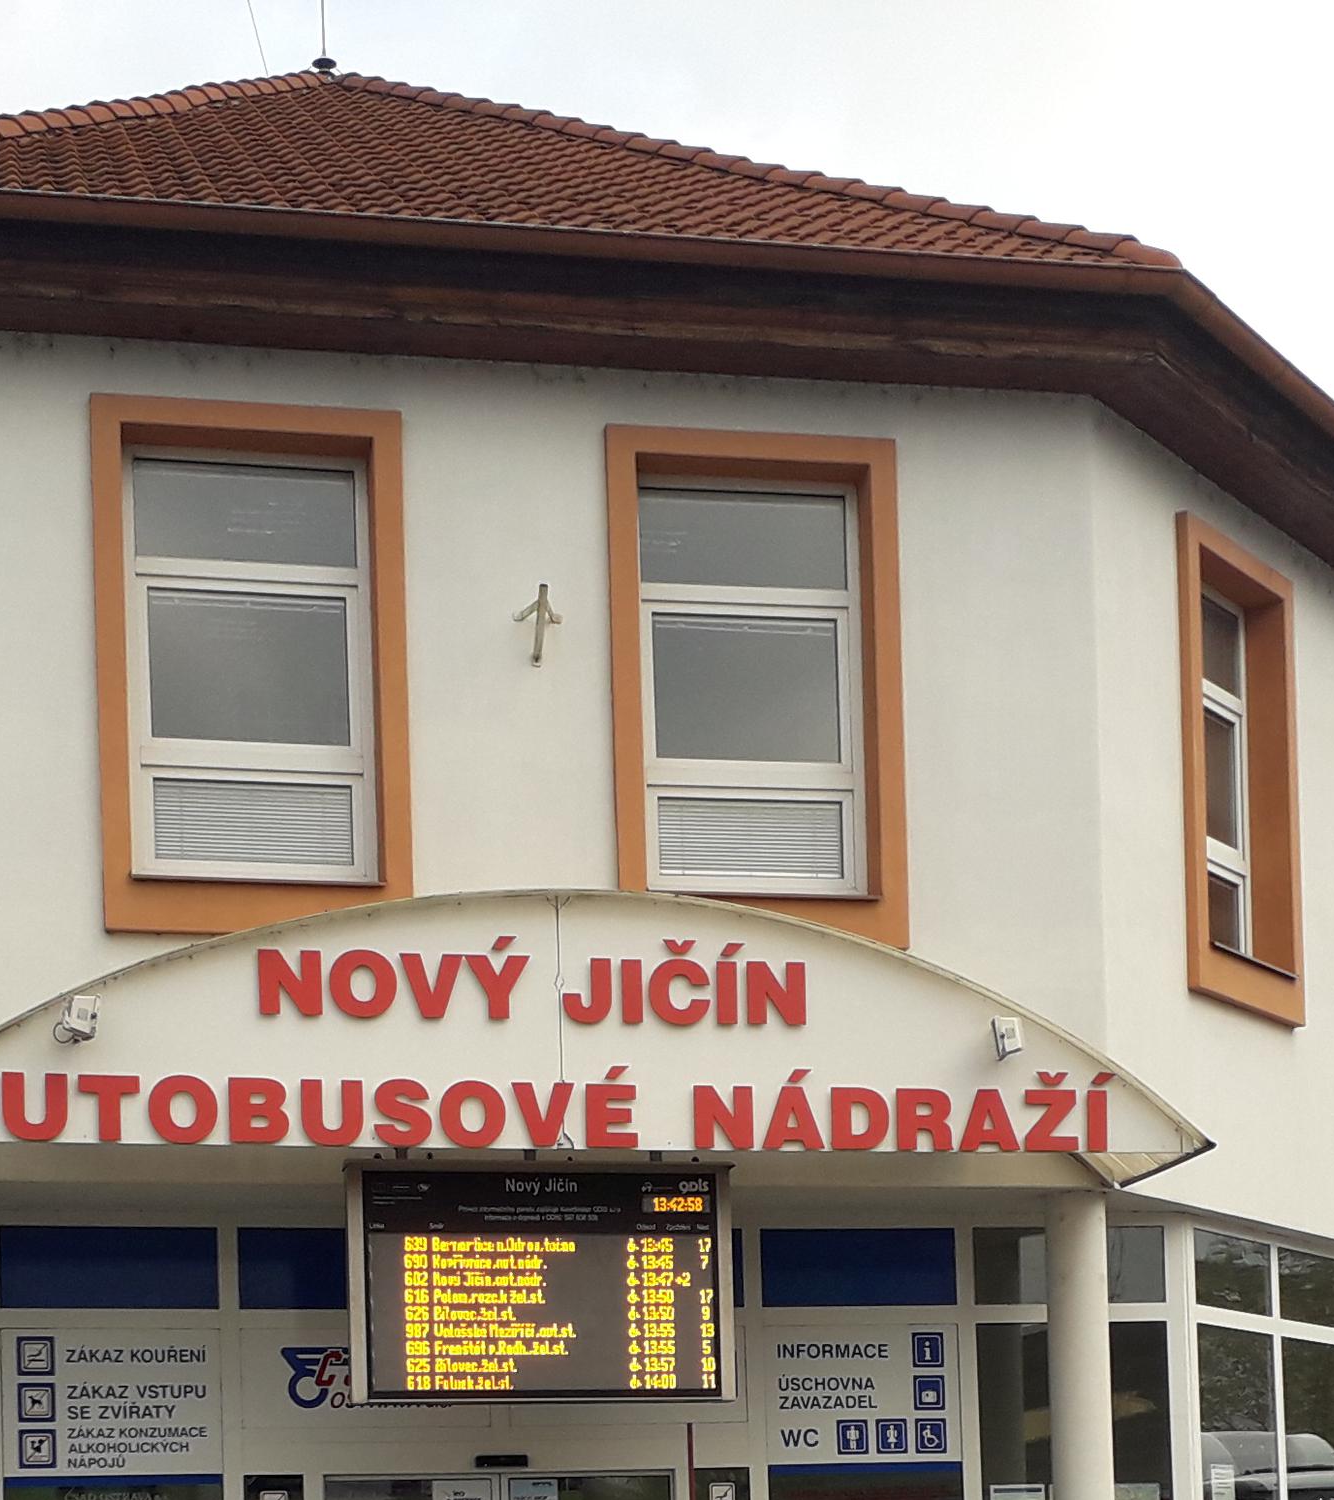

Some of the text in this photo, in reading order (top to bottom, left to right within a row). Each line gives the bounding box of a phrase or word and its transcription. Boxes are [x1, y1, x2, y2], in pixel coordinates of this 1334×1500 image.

[258, 936, 808, 1026] NOVÝ JIČÍN
[694, 1069, 1114, 1153] NÁDRAŽÍ
[504, 1177, 578, 1196] Nový Jičín
[652, 1196, 703, 1212] 13:42:58
[404, 1237, 427, 1252] 639
[641, 1237, 673, 1252] 13:45
[698, 1237, 711, 1252] 17
[404, 1253, 428, 1269] 690
[641, 1253, 673, 1269] 13:45
[700, 1253, 709, 1269] 7
[404, 1271, 428, 1287] 602
[642, 1271, 673, 1287] 13:47
[404, 1288, 429, 1304] 616
[642, 1288, 674, 1304] 13:50
[699, 1288, 713, 1304] 17
[405, 1305, 429, 1321] 626
[643, 1305, 674, 1321] 13:50
[701, 1305, 711, 1321] 9
[405, 1322, 429, 1338] 987
[643, 1322, 675, 1338] 13:55
[700, 1322, 715, 1338] 13
[66, 1345, 206, 1364] ZÁKAZ KOUŘENÍ
[406, 1340, 430, 1355] 696
[644, 1340, 675, 1355] 13:55
[702, 1340, 711, 1355] 5
[777, 1343, 889, 1360] INFORMACE
[406, 1357, 430, 1372] 625
[644, 1357, 675, 1372] 13:57
[701, 1357, 716, 1372] 10
[407, 1374, 431, 1390] 618
[644, 1374, 676, 1390] 14:00
[701, 1374, 716, 1390] 11
[778, 1374, 875, 1392] ÚSCHOVNA
[67, 1382, 207, 1400] ZÁKAZ VSTUPU
[67, 1401, 176, 1420] SE ZVÍŘATY
[778, 1395, 878, 1410] ZAVAZADEL
[67, 1426, 208, 1440] ZÁKAZ KONZUMACE
[780, 1429, 820, 1448] WC
[68, 1440, 190, 1454] ALKOHOLICKÝCH
[68, 1455, 126, 1470] NÁPOJŮ
